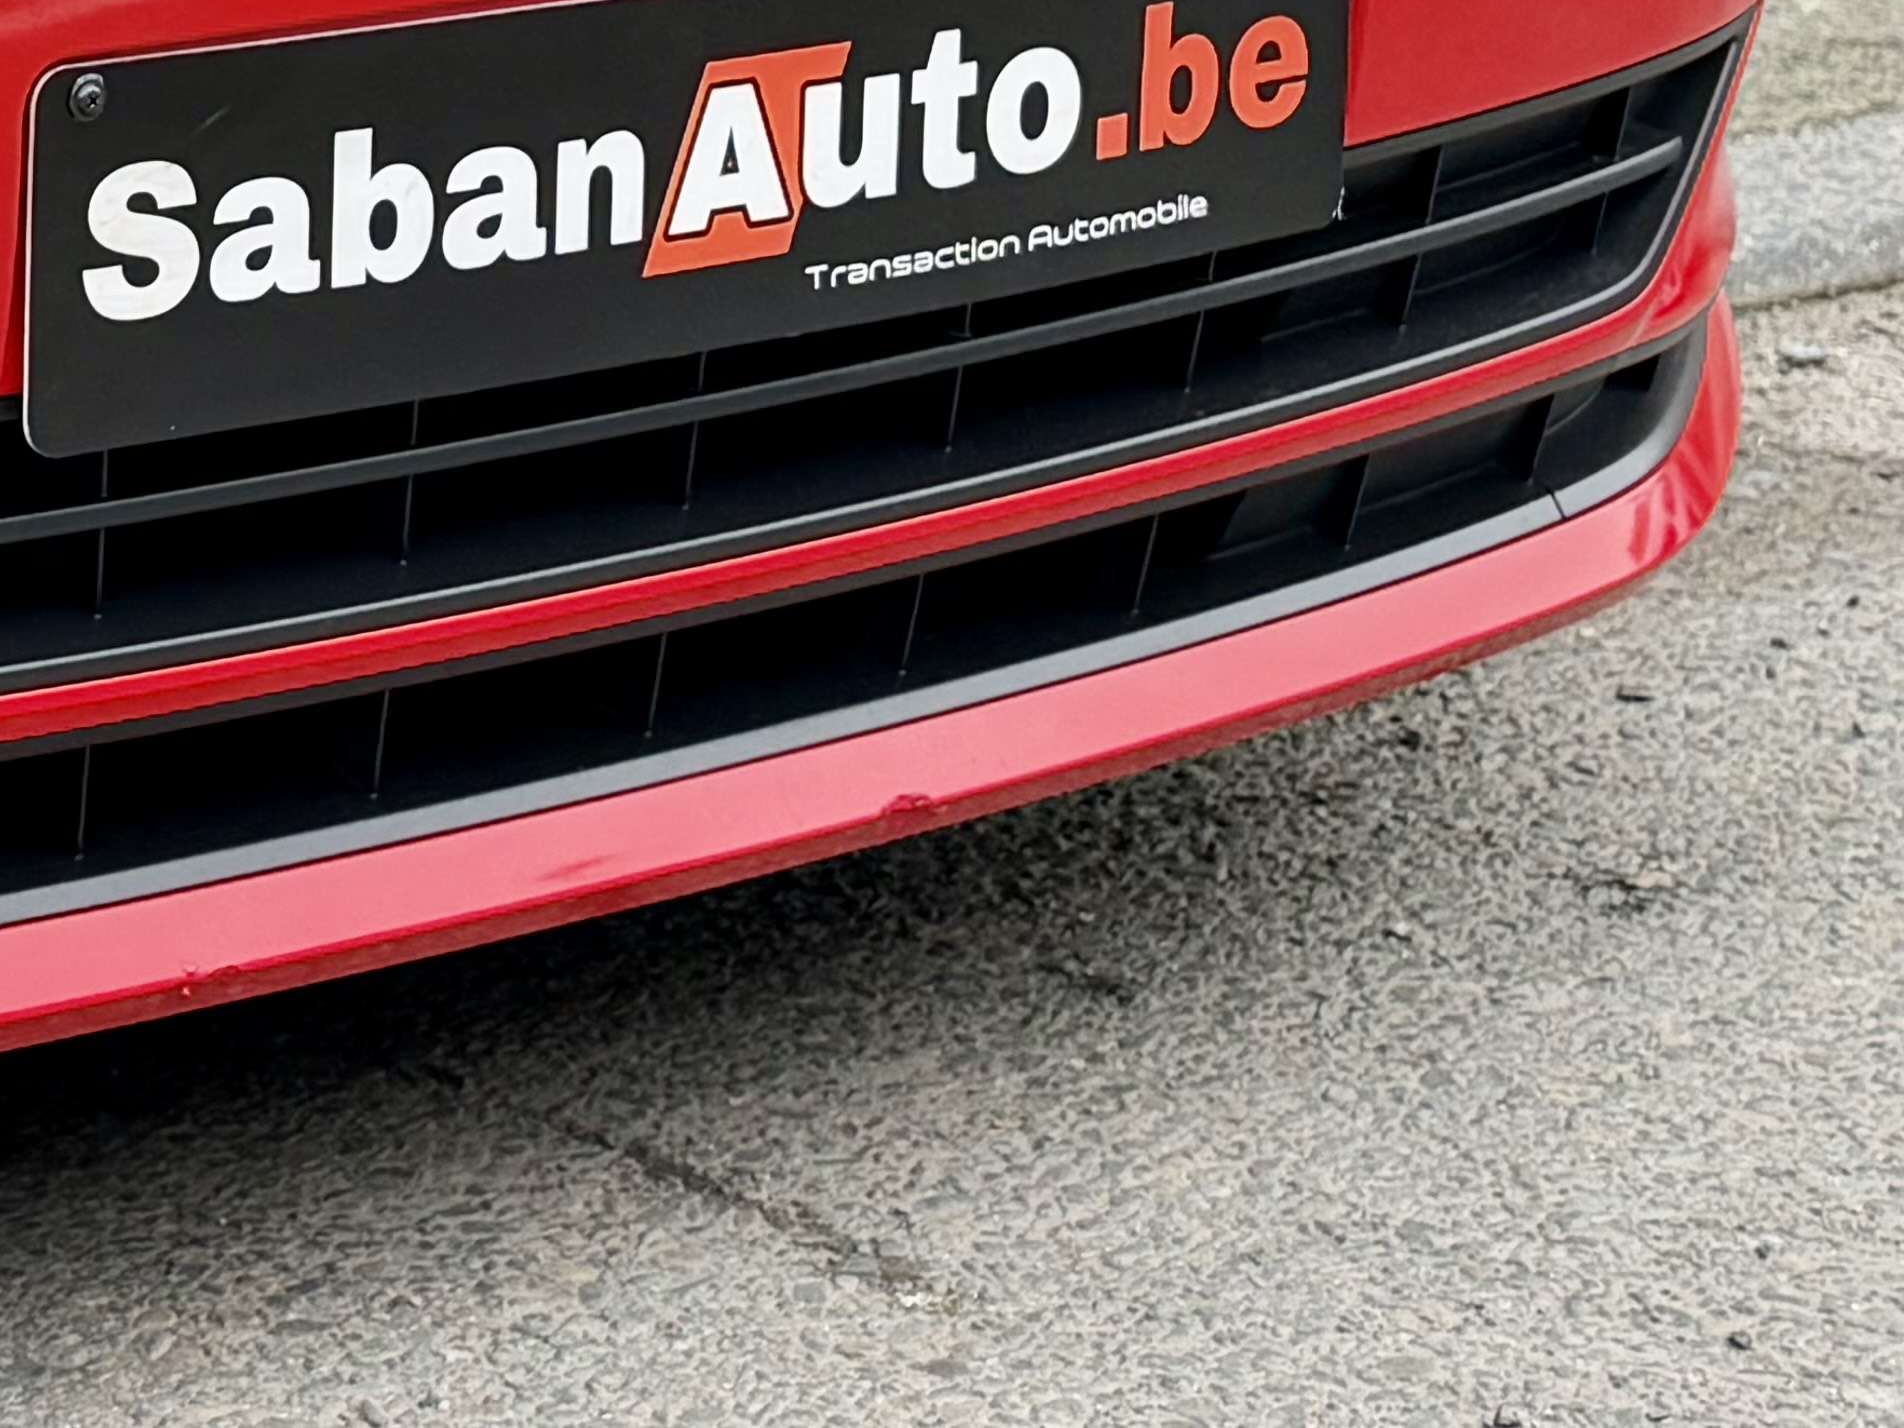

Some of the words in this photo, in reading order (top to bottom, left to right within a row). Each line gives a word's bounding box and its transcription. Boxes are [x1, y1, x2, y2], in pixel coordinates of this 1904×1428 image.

[79, 0, 1311, 324] SabanAuto.be
[804, 232, 1022, 292] Transaction
[1027, 192, 1209, 256] Automobile
